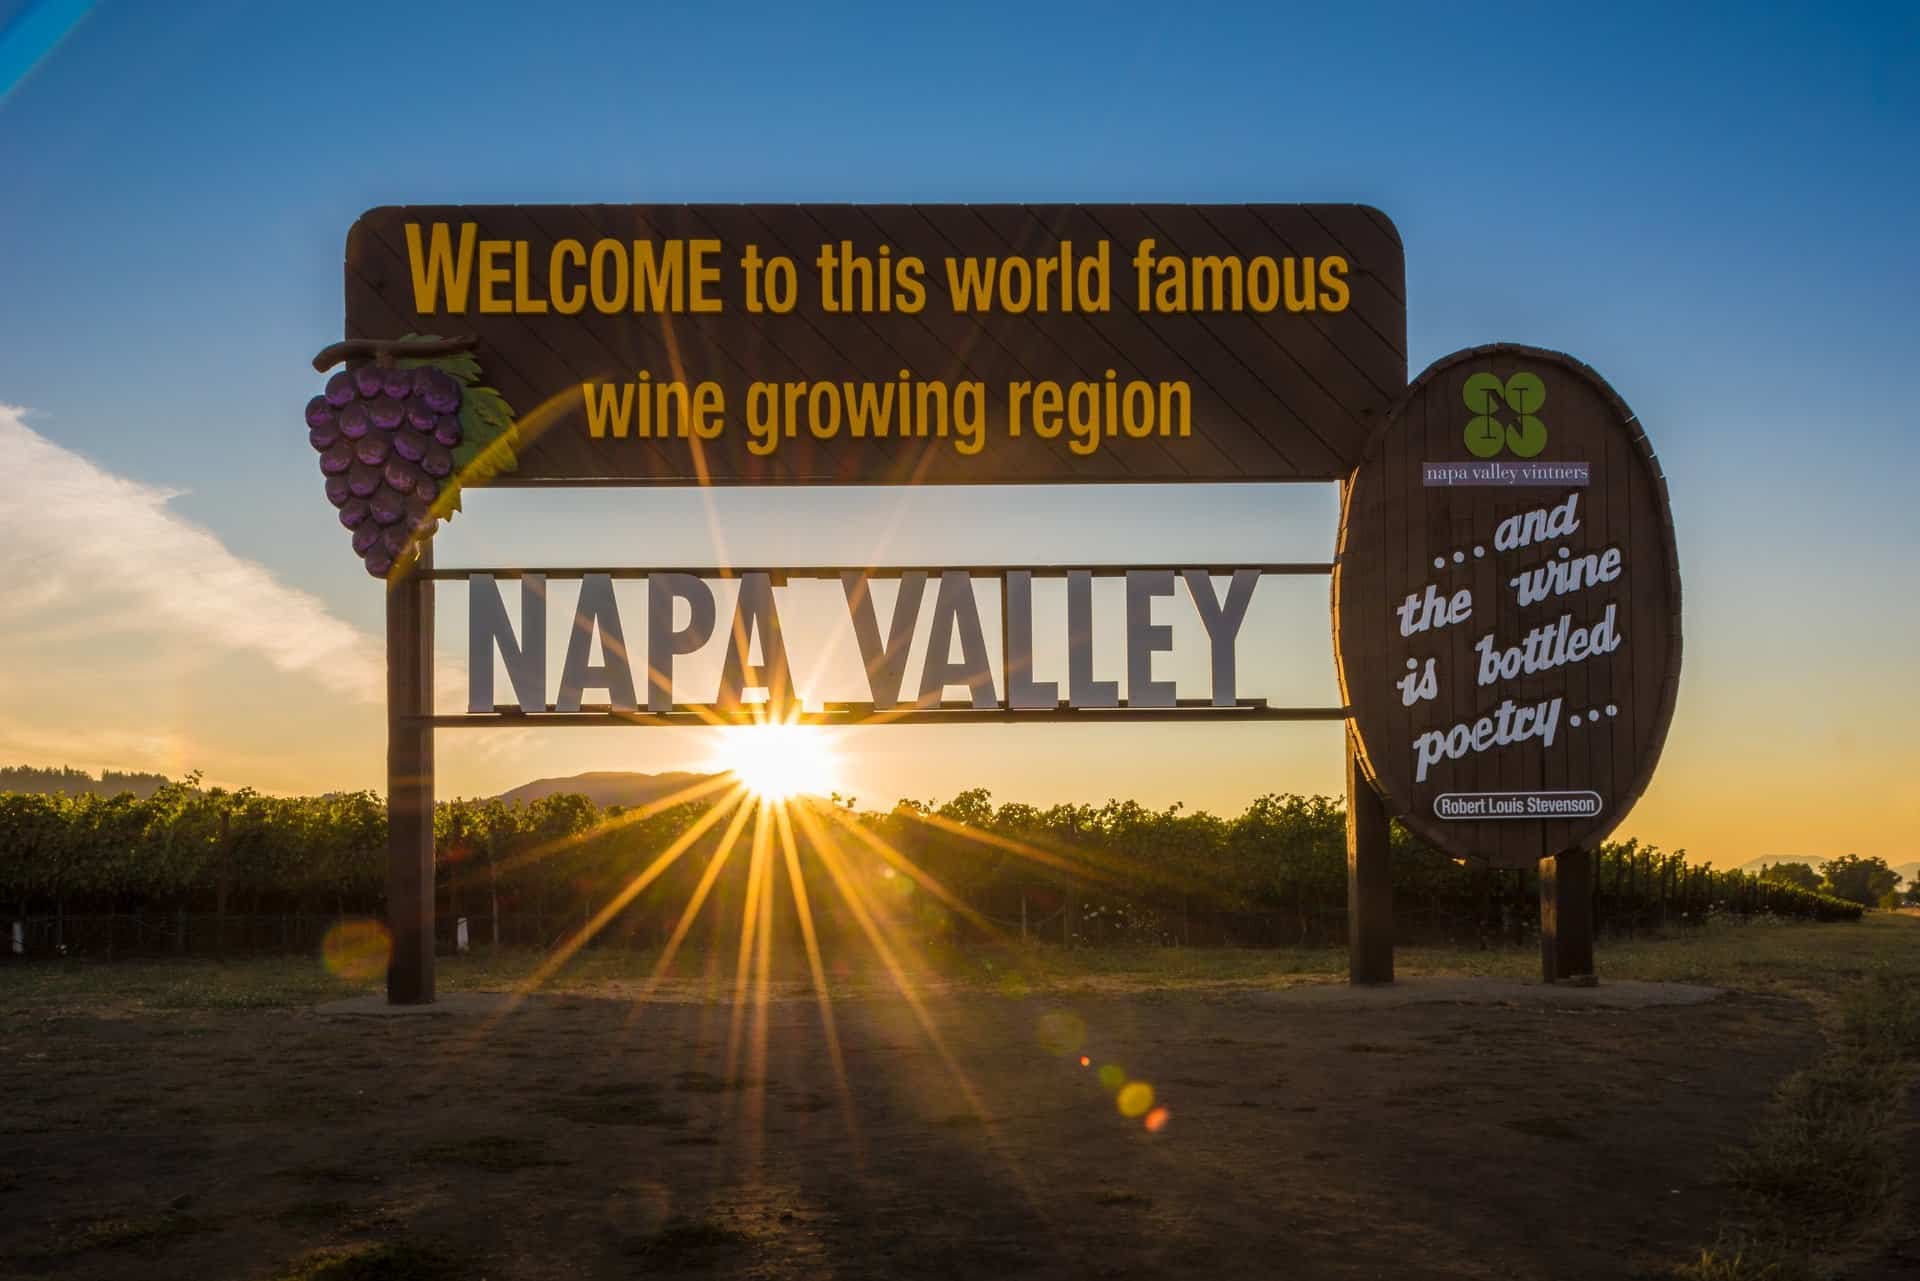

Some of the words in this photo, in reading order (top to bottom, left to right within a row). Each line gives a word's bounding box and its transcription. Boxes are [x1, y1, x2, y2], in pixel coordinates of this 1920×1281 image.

[405, 222, 722, 314] WELCOME
[740, 244, 797, 313] to
[816, 240, 926, 313] this
[945, 240, 1110, 313] world
[1133, 238, 1350, 313] famous
[582, 370, 724, 439] wine
[746, 369, 985, 455] growing
[1009, 369, 1191, 455] region
[1426, 467, 1468, 485] napa
[1472, 463, 1519, 484] valley
[1522, 464, 1588, 480] vintners
[1396, 584, 1472, 637] the
[1510, 546, 1621, 607] wine
[467, 572, 802, 713] NAPA
[840, 568, 1262, 710] VALLEY
[1396, 656, 1438, 707] is
[1475, 604, 1621, 687] bottled
[1441, 798, 1486, 815] Robert
[1489, 798, 1524, 814] Louis
[1527, 797, 1596, 813] Stevenson
